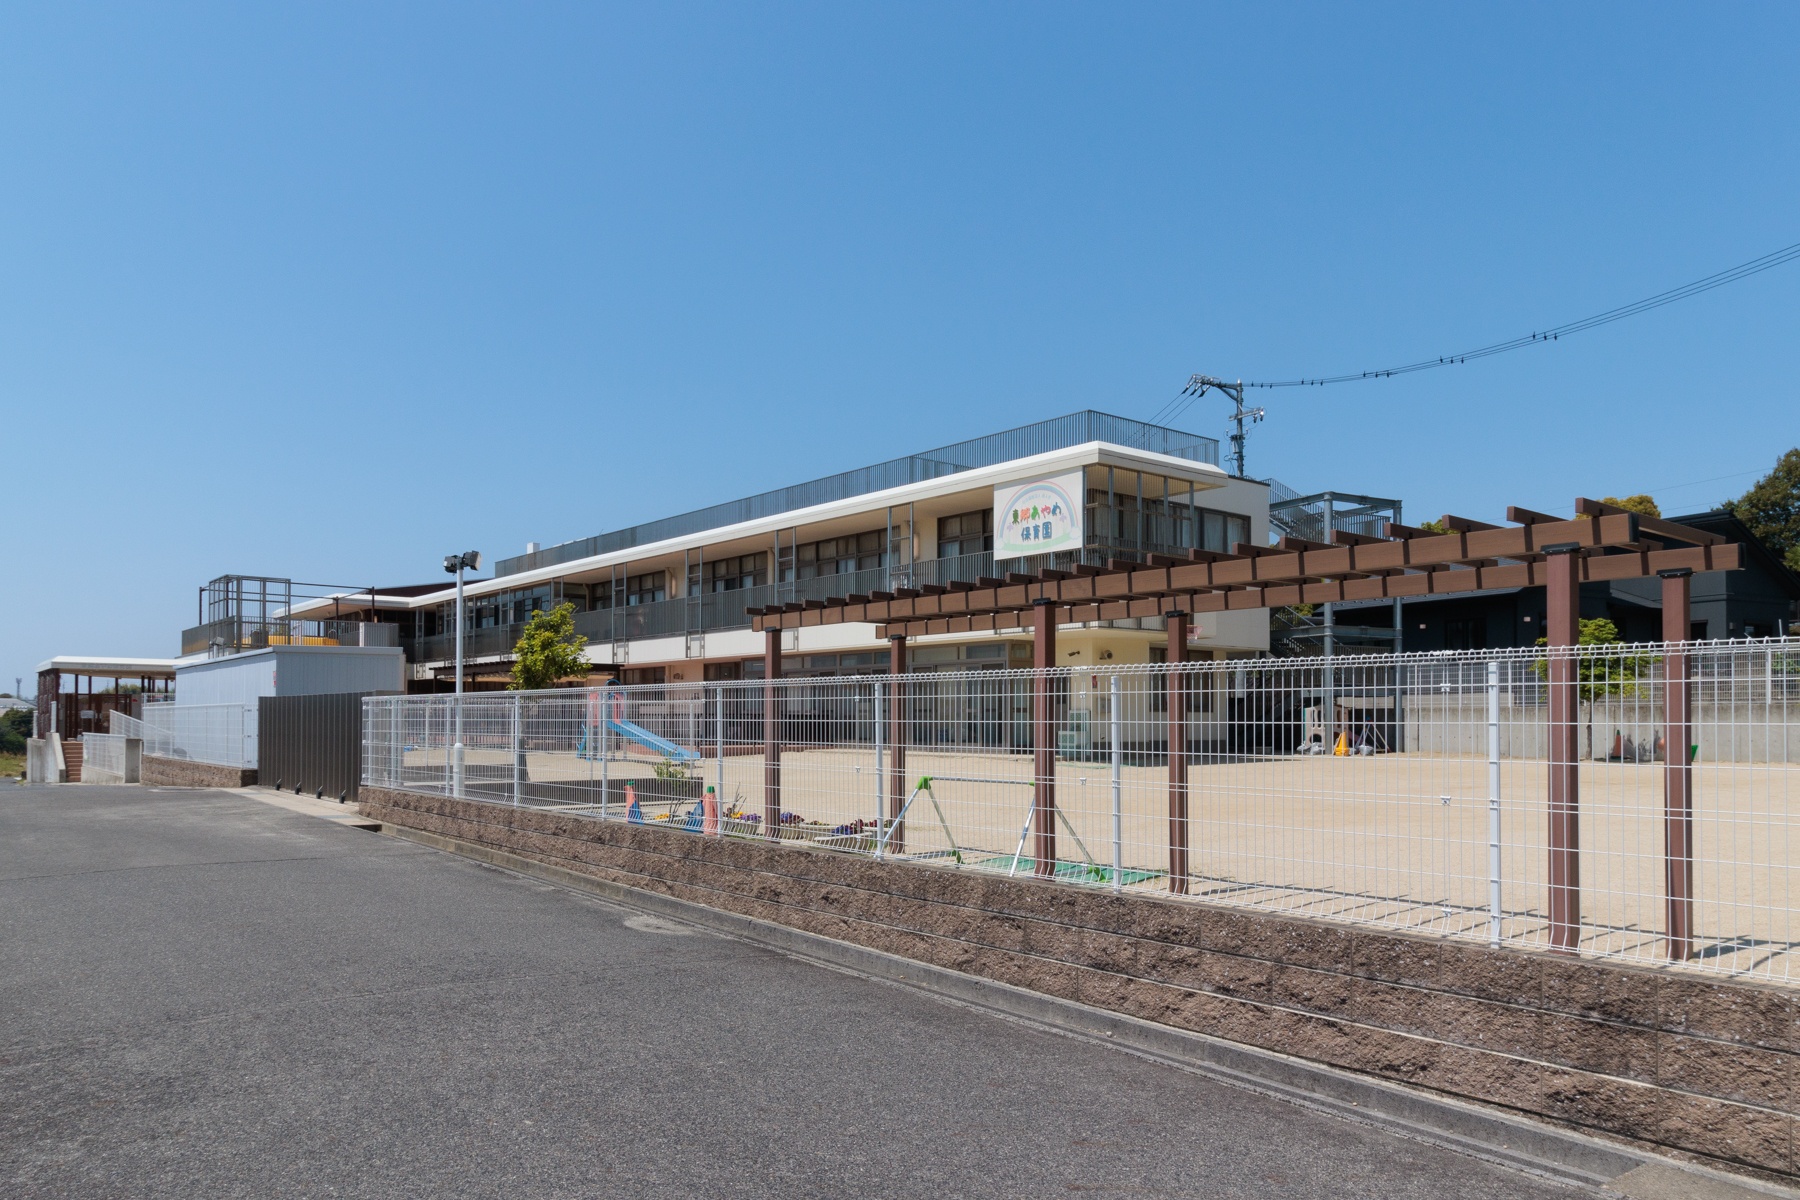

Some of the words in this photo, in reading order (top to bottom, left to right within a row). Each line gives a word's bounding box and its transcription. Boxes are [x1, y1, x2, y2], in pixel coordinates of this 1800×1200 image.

[1012, 502, 1061, 525] 東郷あやめ
[1021, 521, 1052, 542] 保育園
